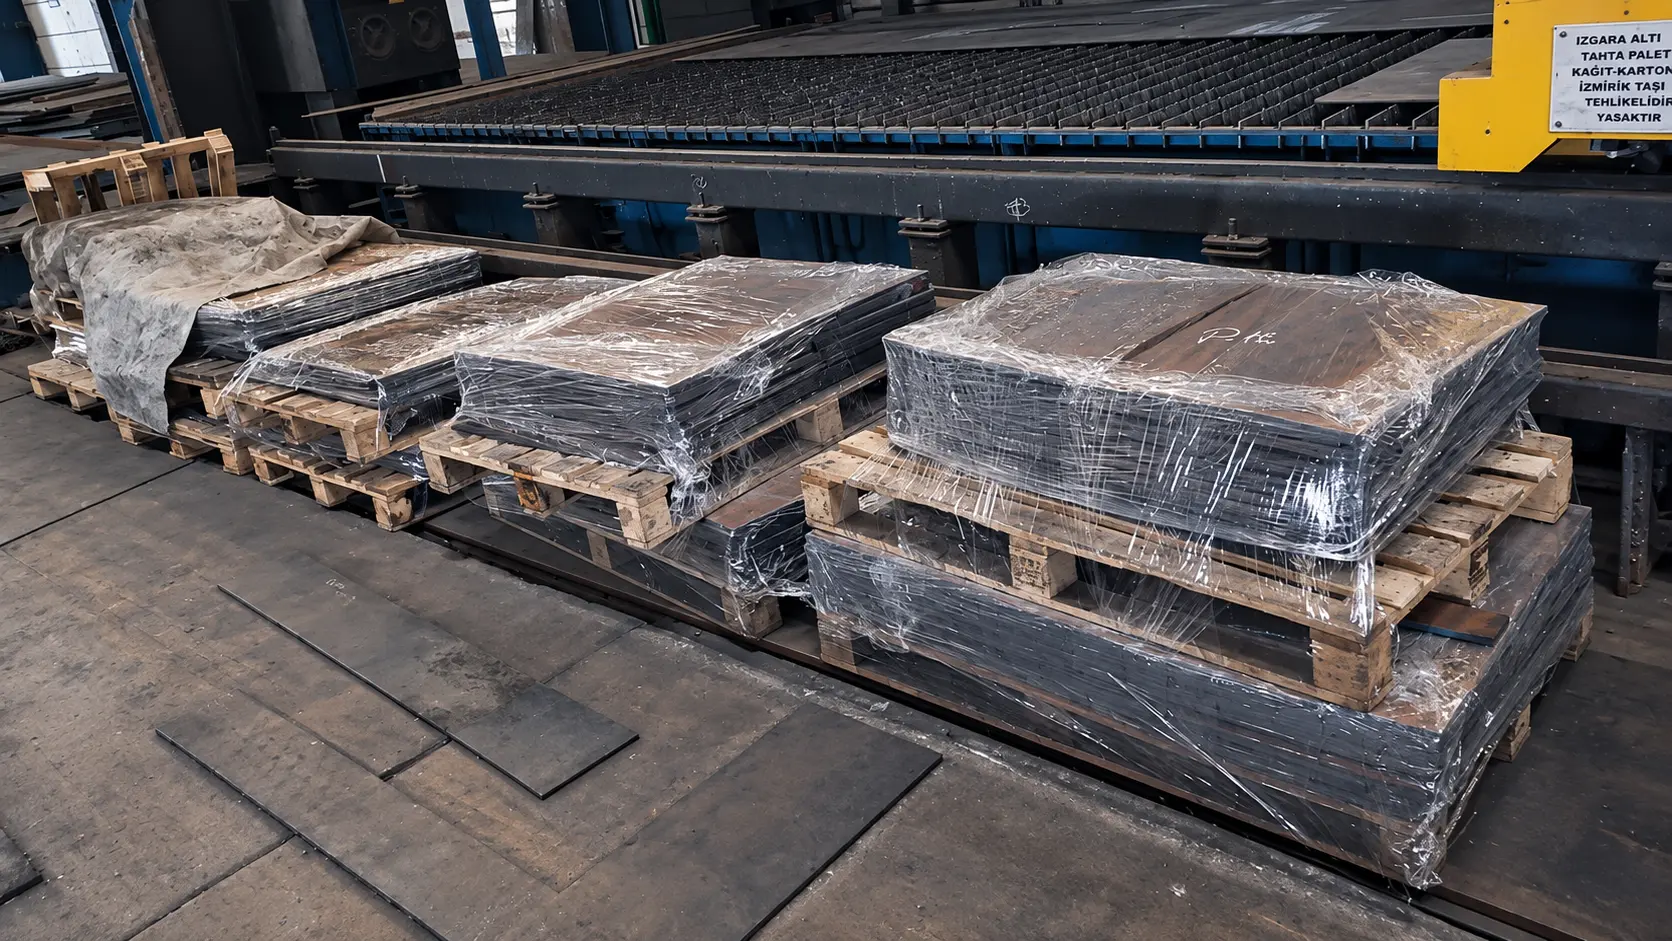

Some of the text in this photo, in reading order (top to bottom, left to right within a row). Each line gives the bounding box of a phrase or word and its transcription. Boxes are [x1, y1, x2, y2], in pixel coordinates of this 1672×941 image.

[1576, 33, 1661, 46] IZGARA ALTI
[1581, 49, 1671, 61] TAHTA PALET
[1579, 80, 1665, 93] İZMİRİK TAŞI
[1585, 95, 1672, 107] TEHLİKELİDİR
[1597, 113, 1661, 122] YASAKTIR
